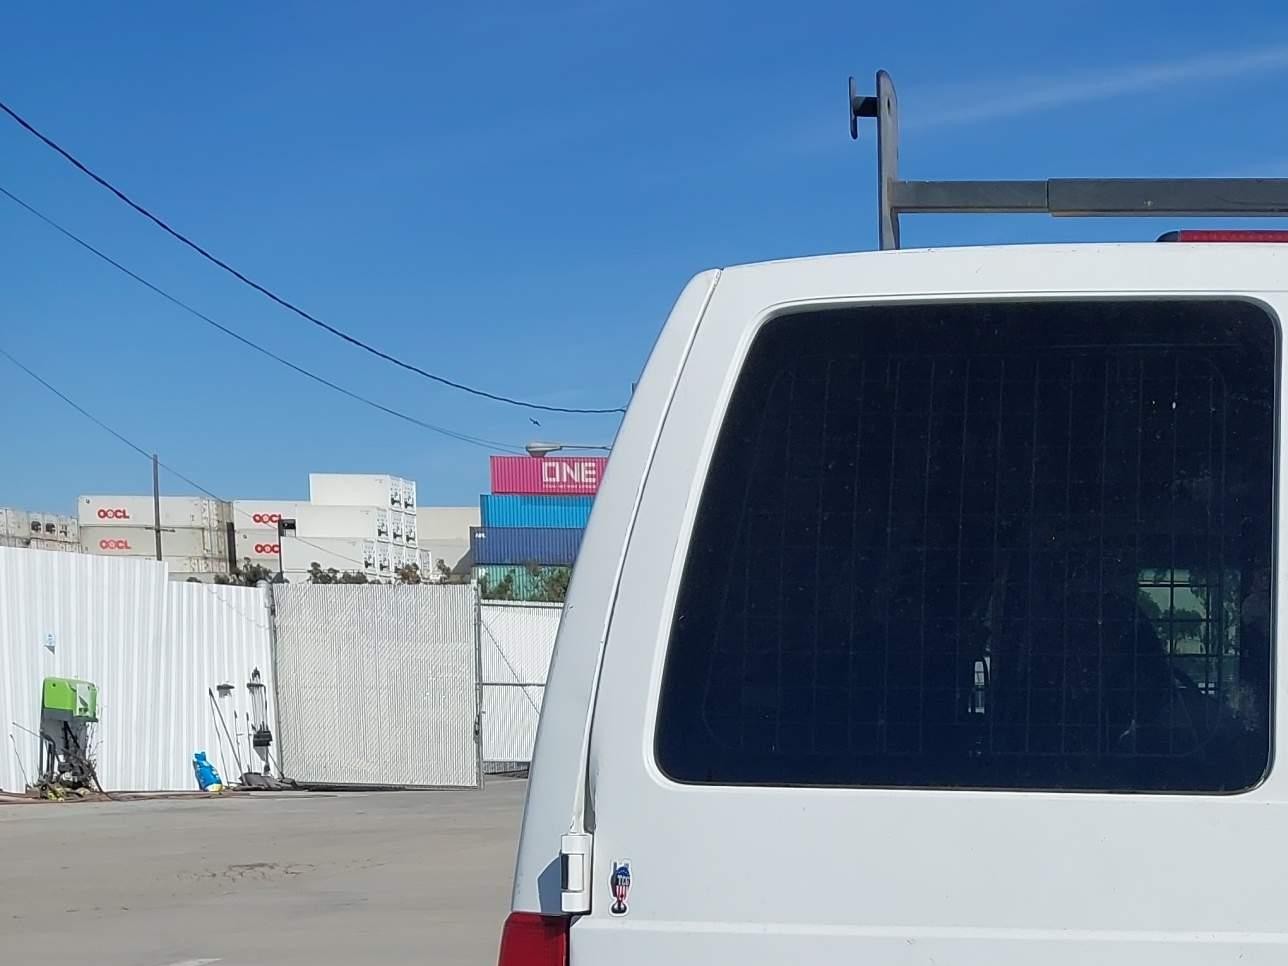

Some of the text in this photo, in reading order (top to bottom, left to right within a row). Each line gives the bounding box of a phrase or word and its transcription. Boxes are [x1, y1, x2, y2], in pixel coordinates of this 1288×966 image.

[542, 461, 596, 482] ONE
[97, 508, 130, 519] OOCL
[99, 539, 131, 550] OOCL
[254, 543, 281, 554] OOC
